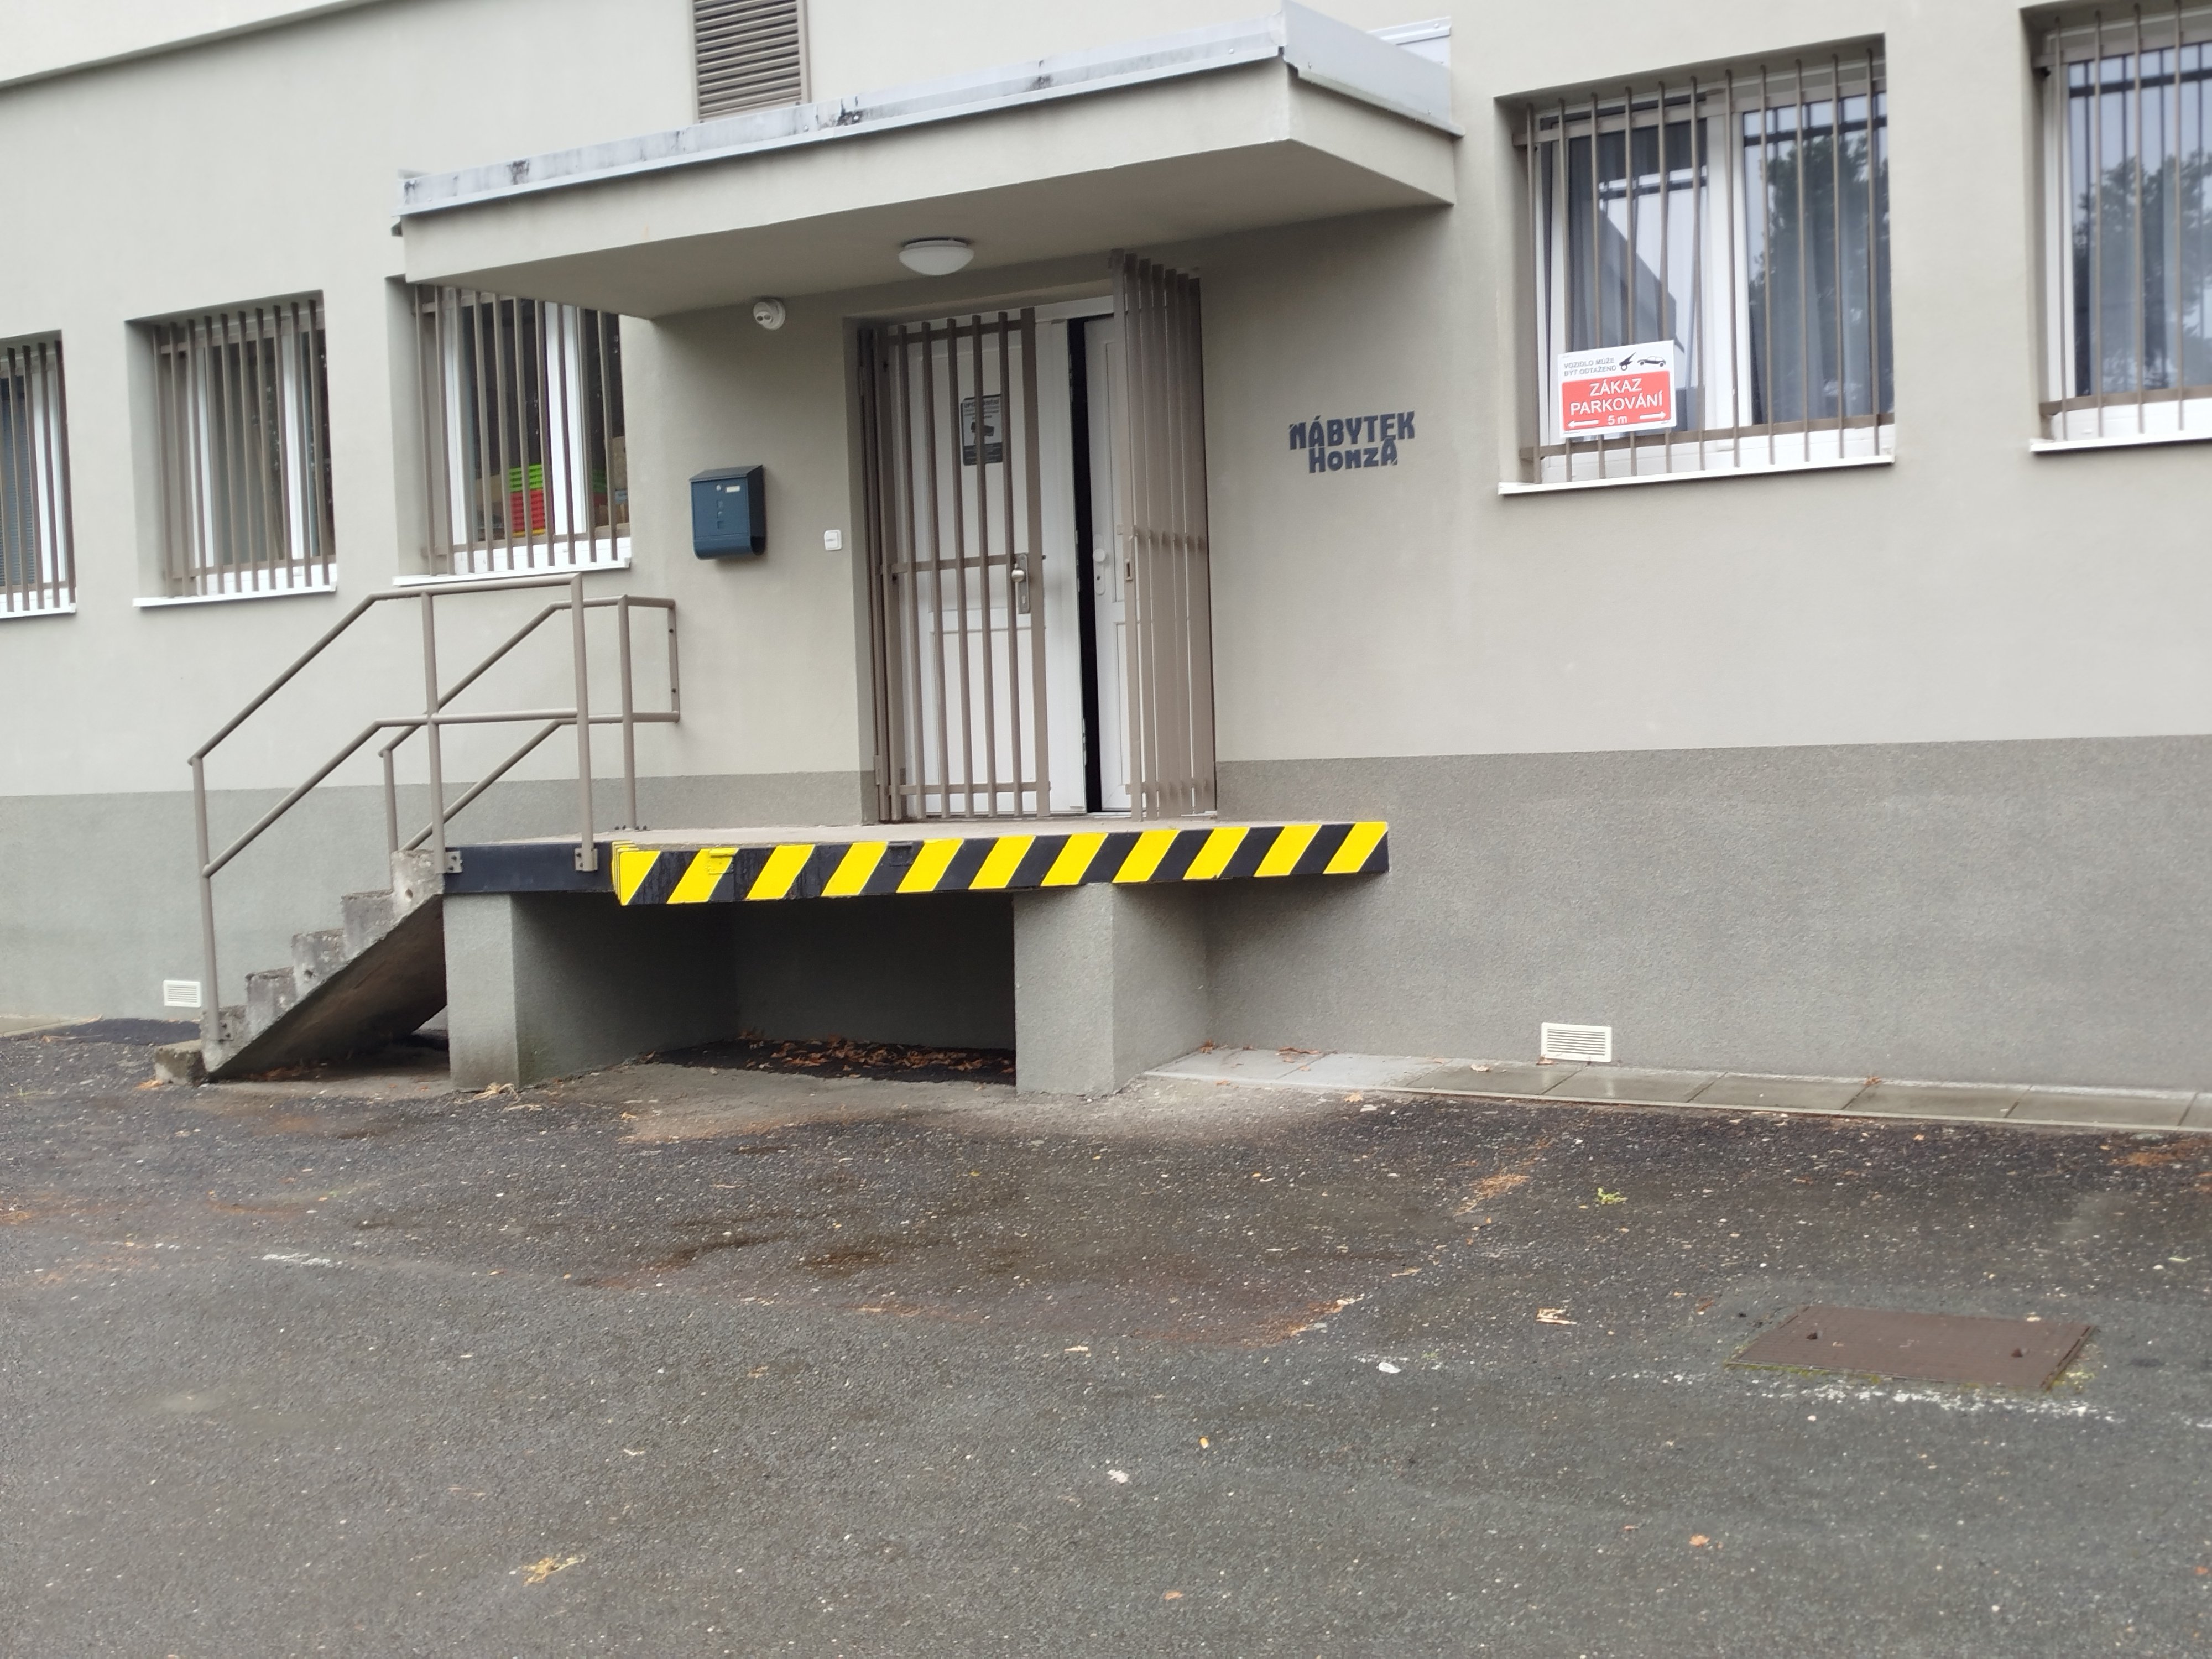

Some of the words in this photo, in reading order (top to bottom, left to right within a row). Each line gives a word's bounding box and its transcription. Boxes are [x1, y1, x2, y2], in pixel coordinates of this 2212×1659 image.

[1564, 359, 1594, 369] VOZIDLO
[1579, 364, 1617, 375] ODTAŽENO
[1589, 378, 1642, 397] ZÁKAZ
[1570, 390, 1663, 416] PARKOVÁNÍ
[1607, 415, 1615, 425] 5
[1618, 415, 1628, 424] m
[1288, 410, 1416, 450] NÁBYTEK
[1308, 436, 1399, 474] HONZA
